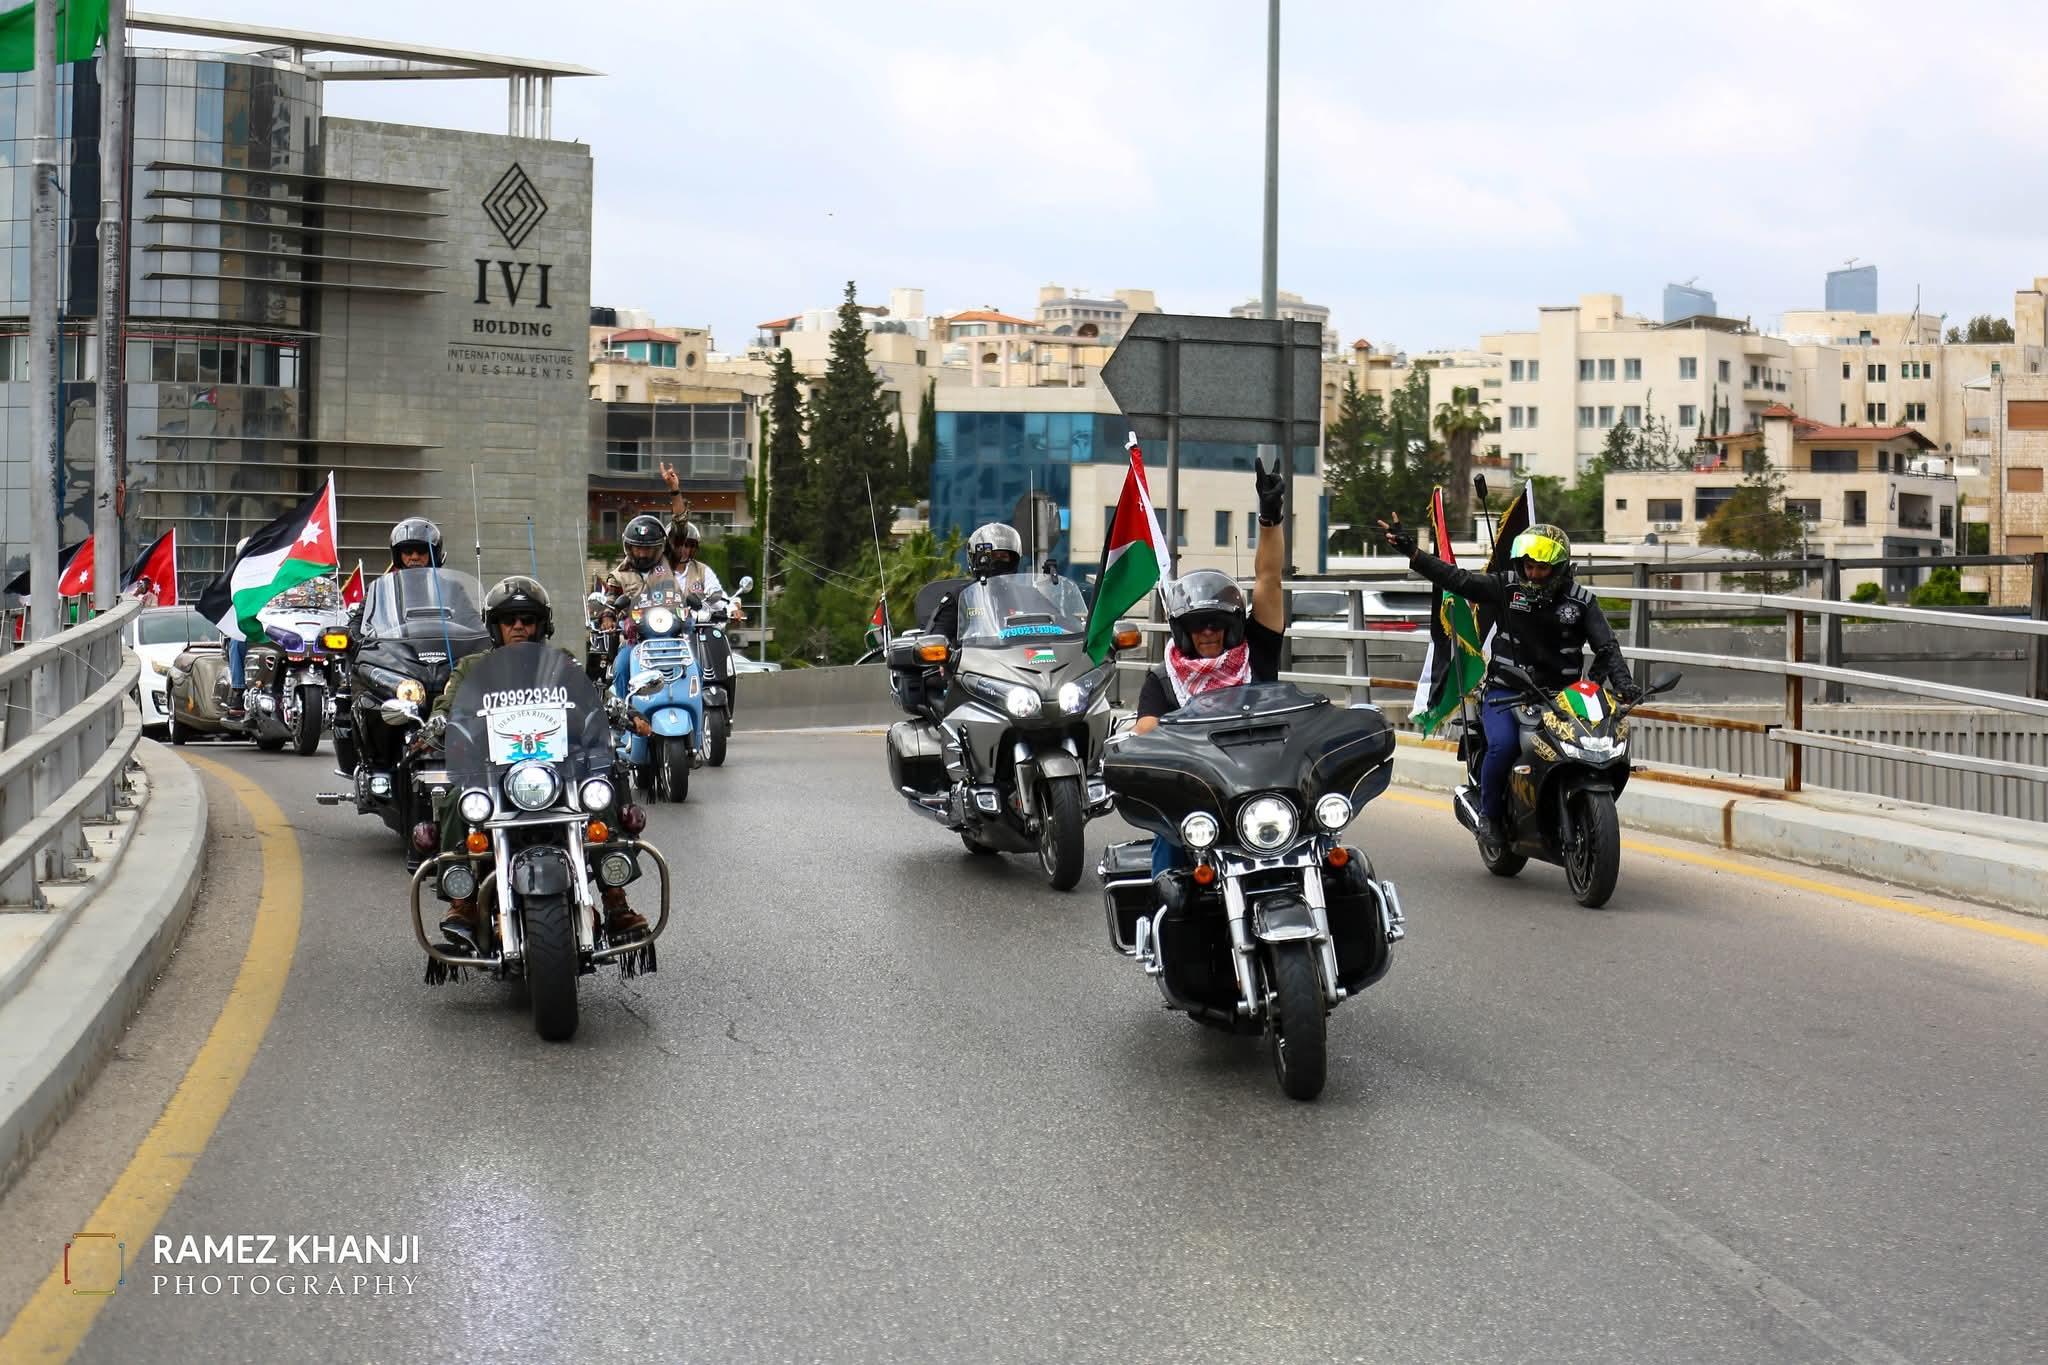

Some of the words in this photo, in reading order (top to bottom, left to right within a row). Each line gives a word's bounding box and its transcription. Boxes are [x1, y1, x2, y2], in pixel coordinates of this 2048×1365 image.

[473, 259, 553, 309] IVI
[473, 319, 553, 337] HOLDING
[447, 349, 526, 363] INTERNATIONAL
[529, 353, 574, 366] VENTURE
[447, 362, 574, 380] INVESTMENTS
[482, 686, 568, 710] 0799929340
[498, 714, 517, 729] DEAD
[517, 710, 531, 719] SEA
[532, 710, 558, 726] RIDERS
